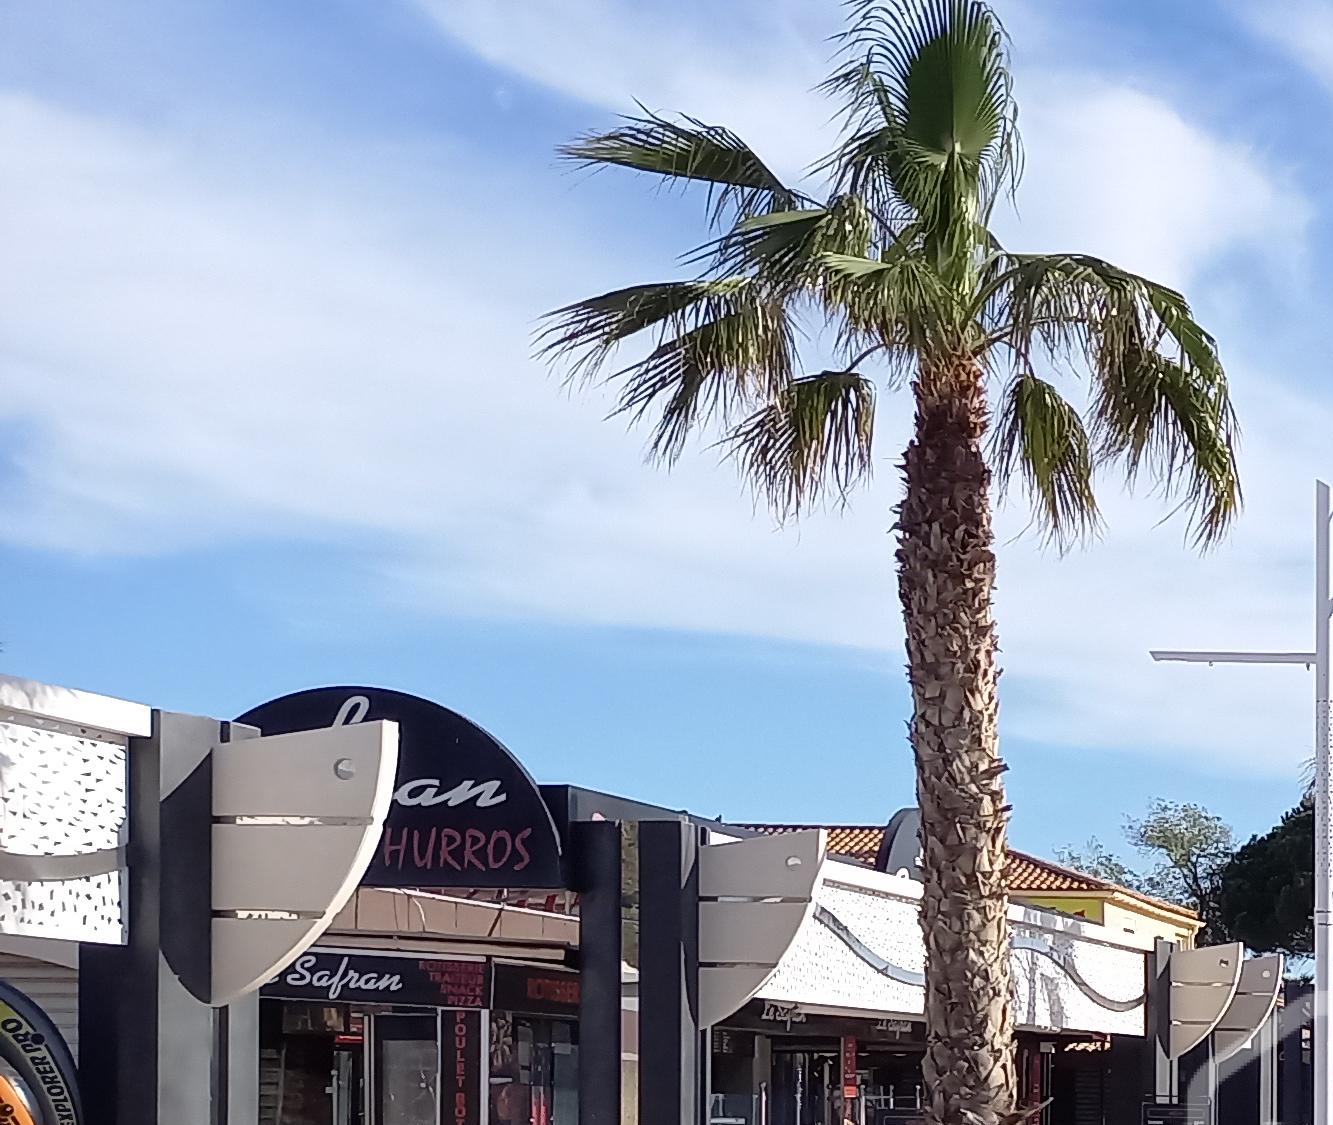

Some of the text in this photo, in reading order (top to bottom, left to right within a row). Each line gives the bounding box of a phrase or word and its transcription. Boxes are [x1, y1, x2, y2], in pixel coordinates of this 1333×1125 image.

[383, 826, 532, 871] HURROS
[286, 954, 403, 1000] Safran
[441, 984, 483, 996] SNACK
[447, 995, 483, 1007] PIZZA
[1, 1018, 42, 1054] PRO
[454, 1011, 467, 1088] POULET
